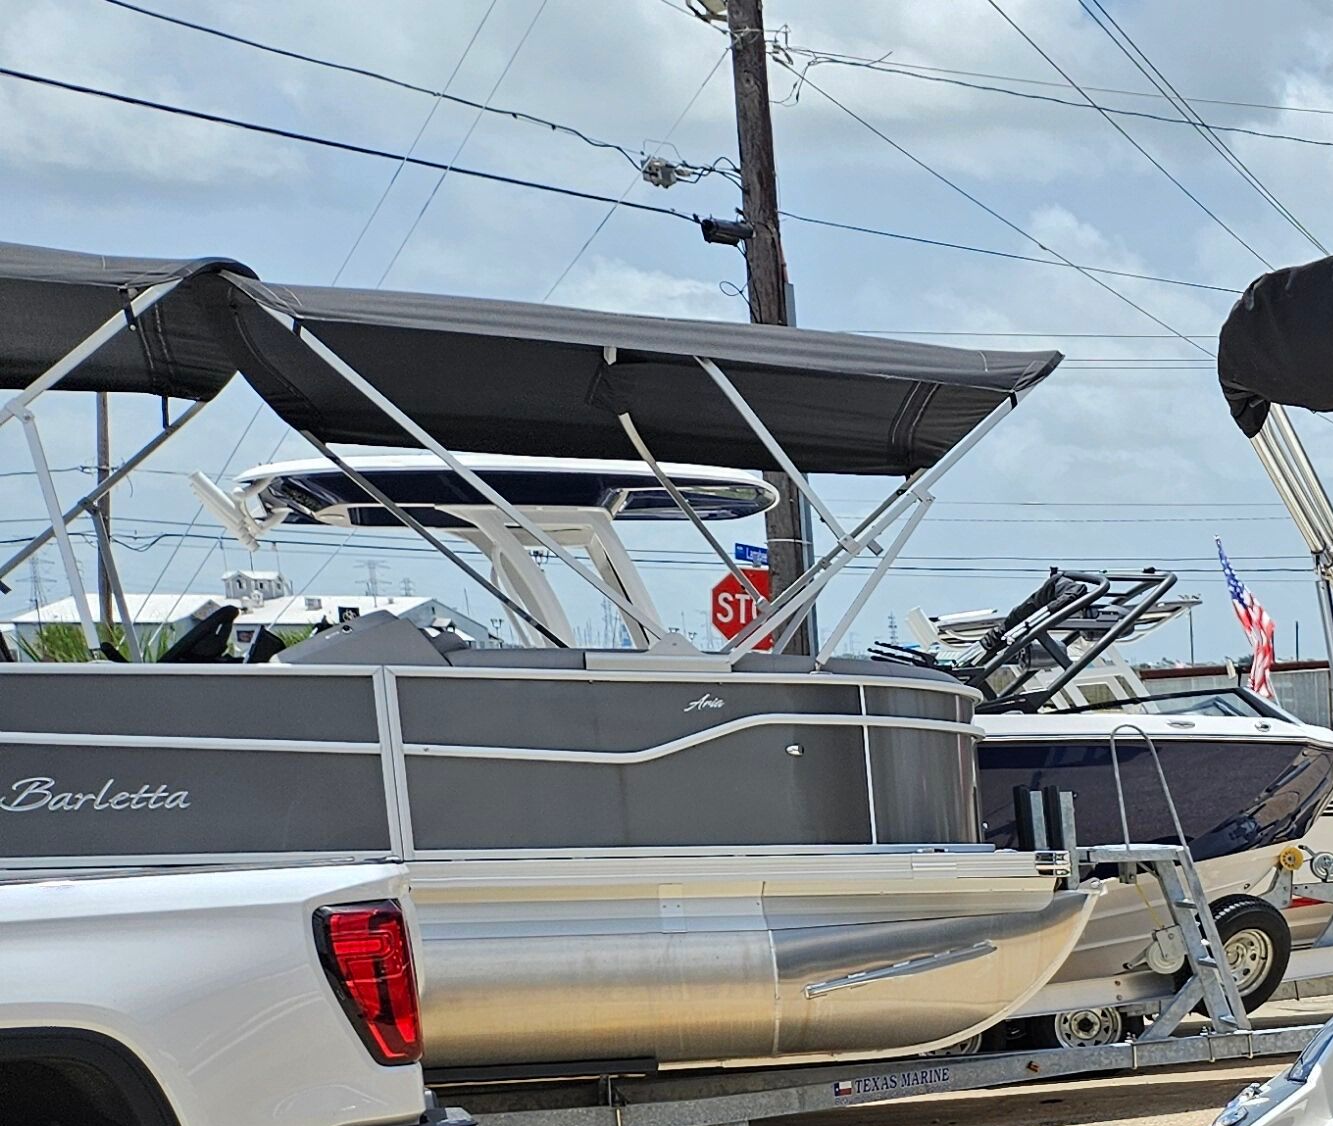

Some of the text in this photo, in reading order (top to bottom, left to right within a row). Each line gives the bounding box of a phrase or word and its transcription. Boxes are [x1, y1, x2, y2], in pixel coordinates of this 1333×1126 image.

[716, 592, 759, 624] ST
[683, 693, 725, 712] Aria
[0, 776, 192, 812] Barletta
[855, 1067, 951, 1094] TEXAS MARINE
